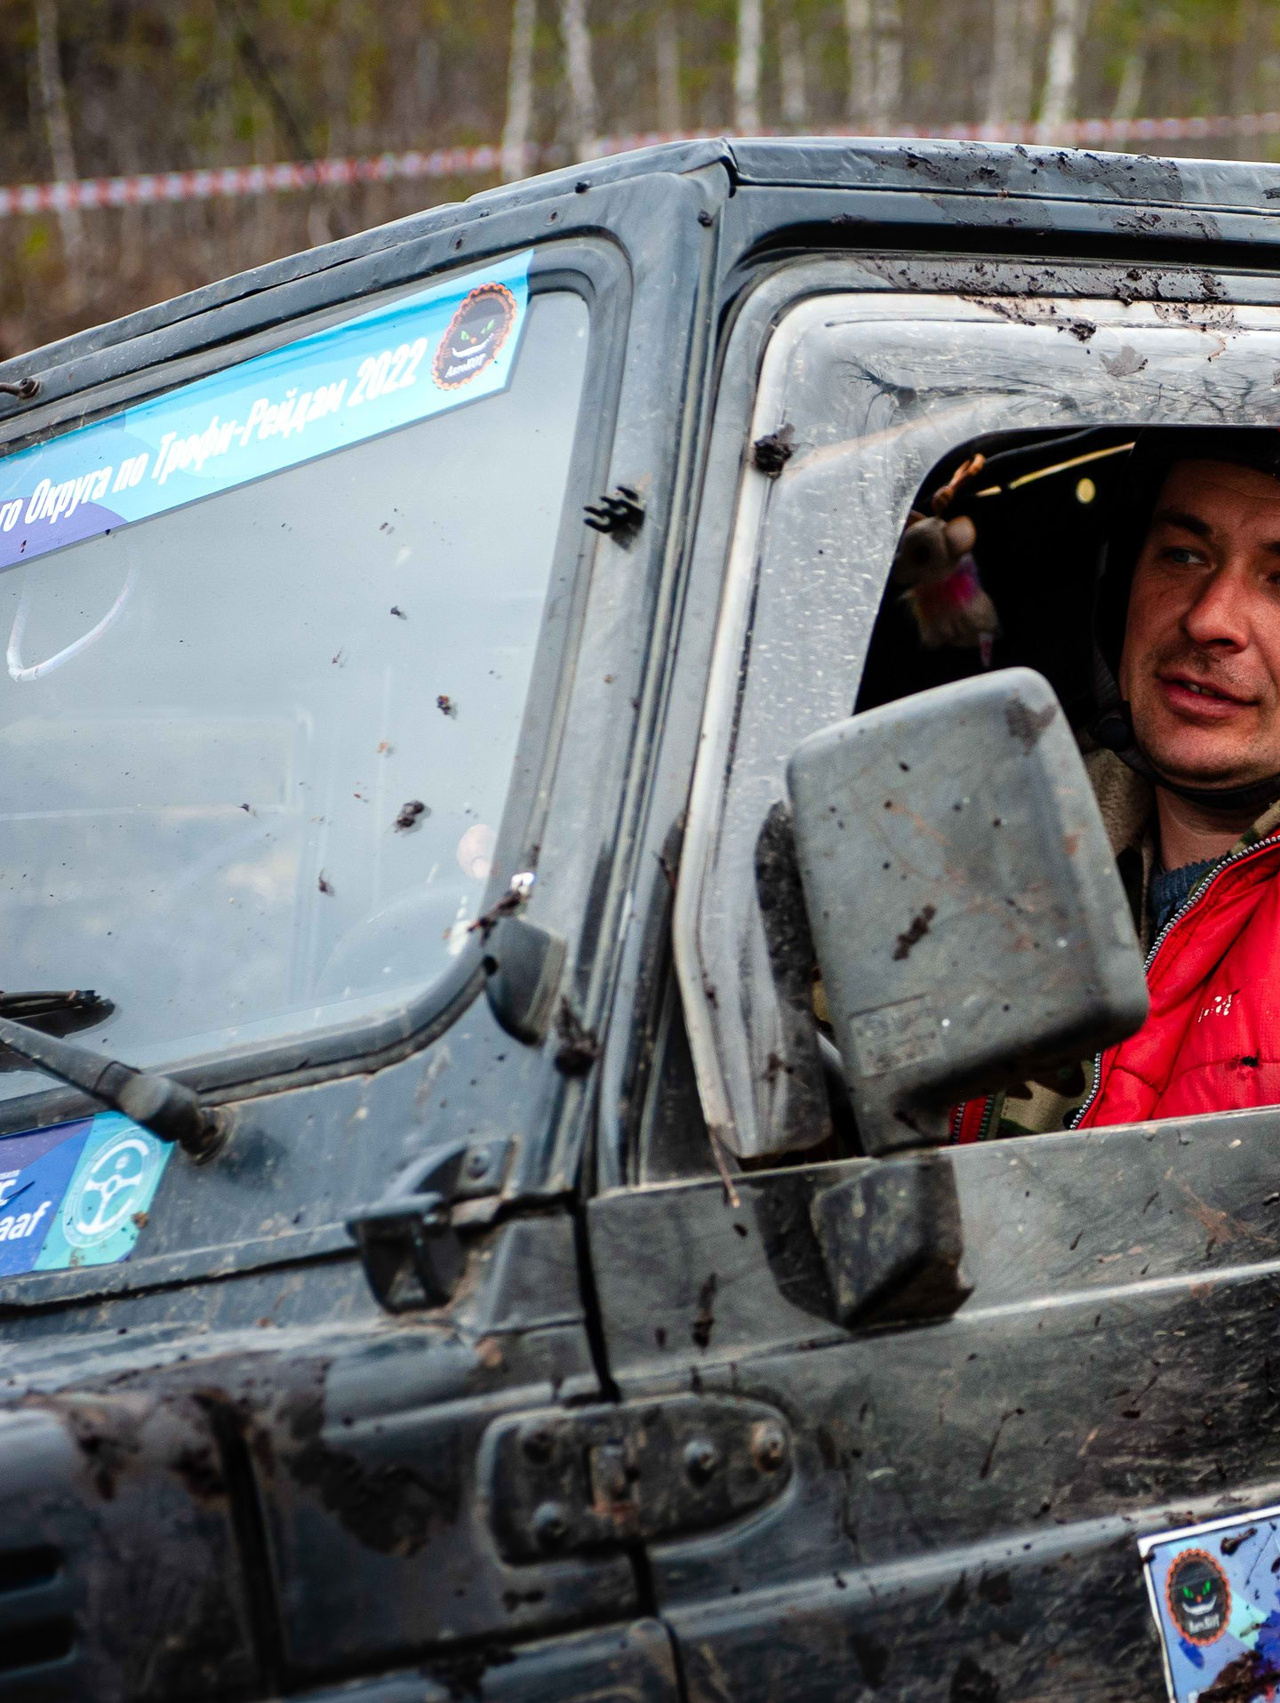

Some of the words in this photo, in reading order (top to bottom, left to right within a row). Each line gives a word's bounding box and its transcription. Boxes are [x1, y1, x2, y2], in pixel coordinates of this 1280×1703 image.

[25, 466, 113, 524] Округа
[112, 453, 149, 494] по
[152, 379, 347, 485] Трофи-Рейдам
[348, 337, 428, 407] 2022
